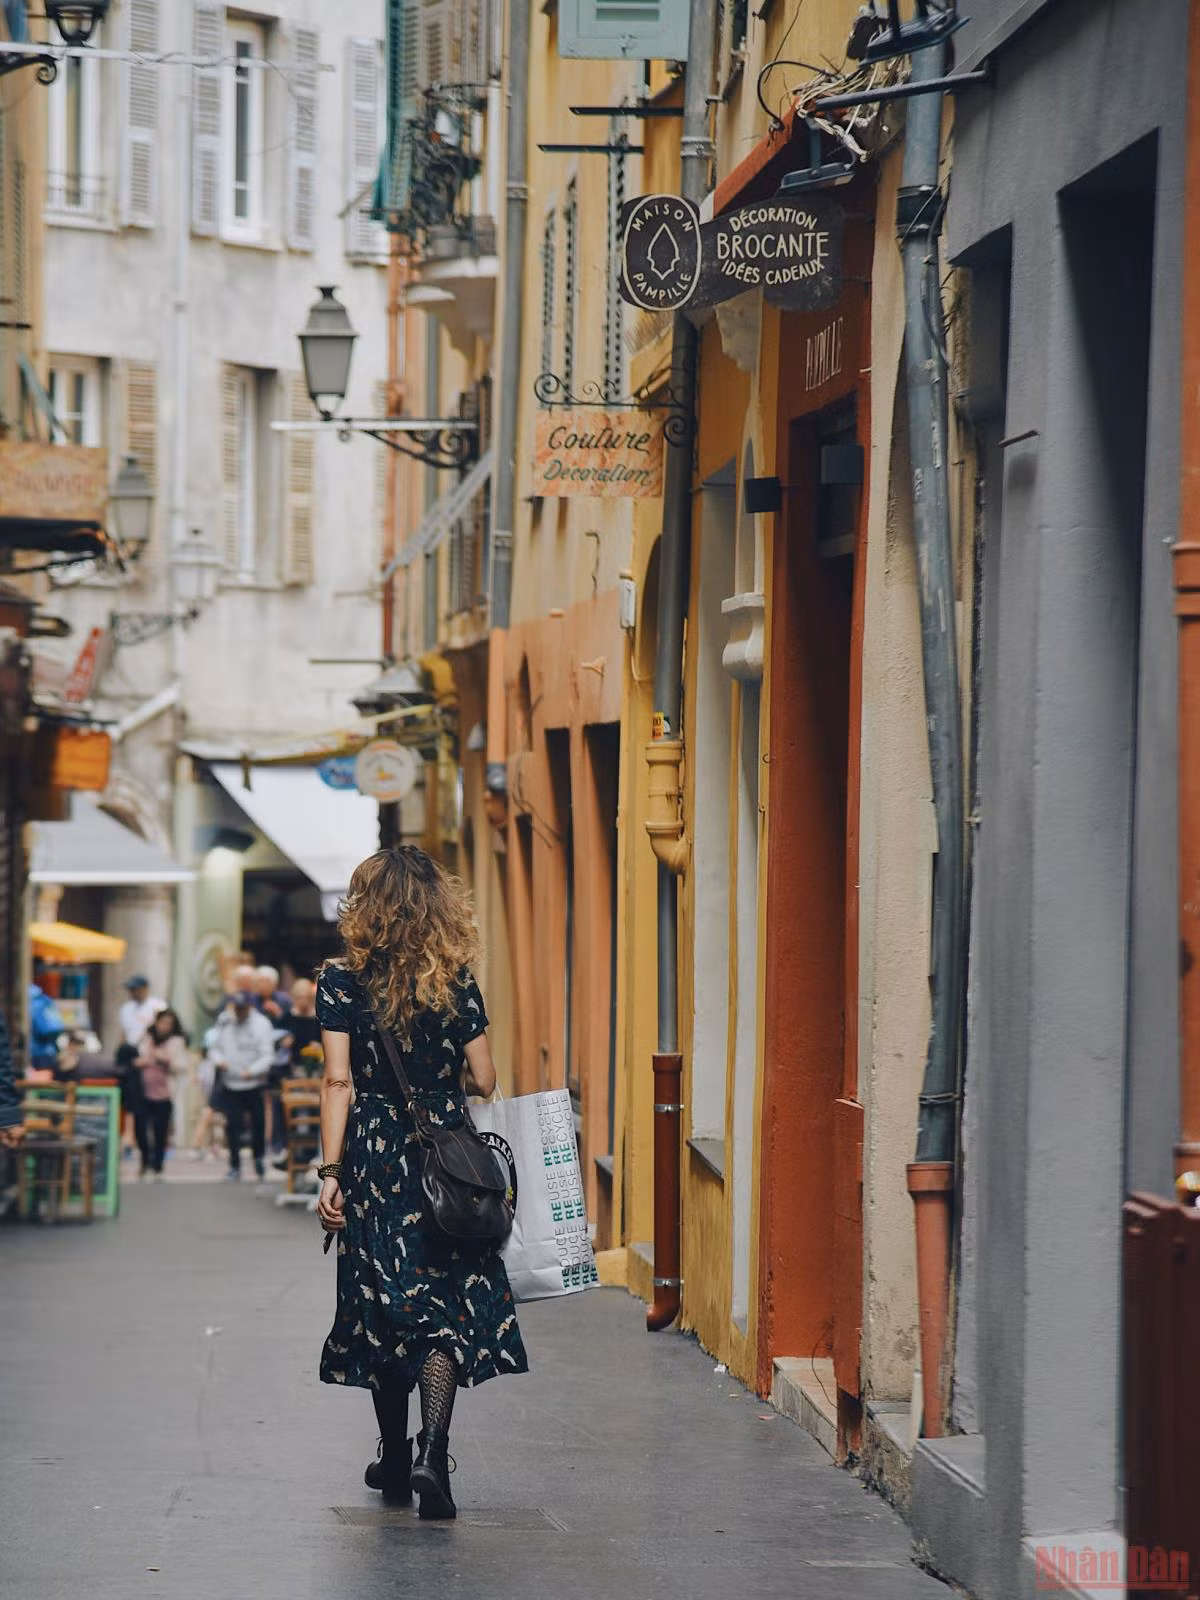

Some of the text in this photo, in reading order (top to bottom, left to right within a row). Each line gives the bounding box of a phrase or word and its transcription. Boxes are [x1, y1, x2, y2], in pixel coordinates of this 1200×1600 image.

[632, 203, 694, 232] MAISON
[729, 207, 818, 233] DÉCORATION
[717, 231, 830, 260] BROCANTE
[721, 257, 825, 285] IDÉES CADEAUX
[633, 272, 692, 300] PAMPILLE
[548, 426, 651, 454] Couture
[541, 1097, 580, 1286] REDUCE REUSE RECYCLE
[546, 1172, 563, 1222] REUSE
[548, 1096, 591, 1284] REDUCE REUSE RECYCLE
[555, 1227, 570, 1288] REDUCE
